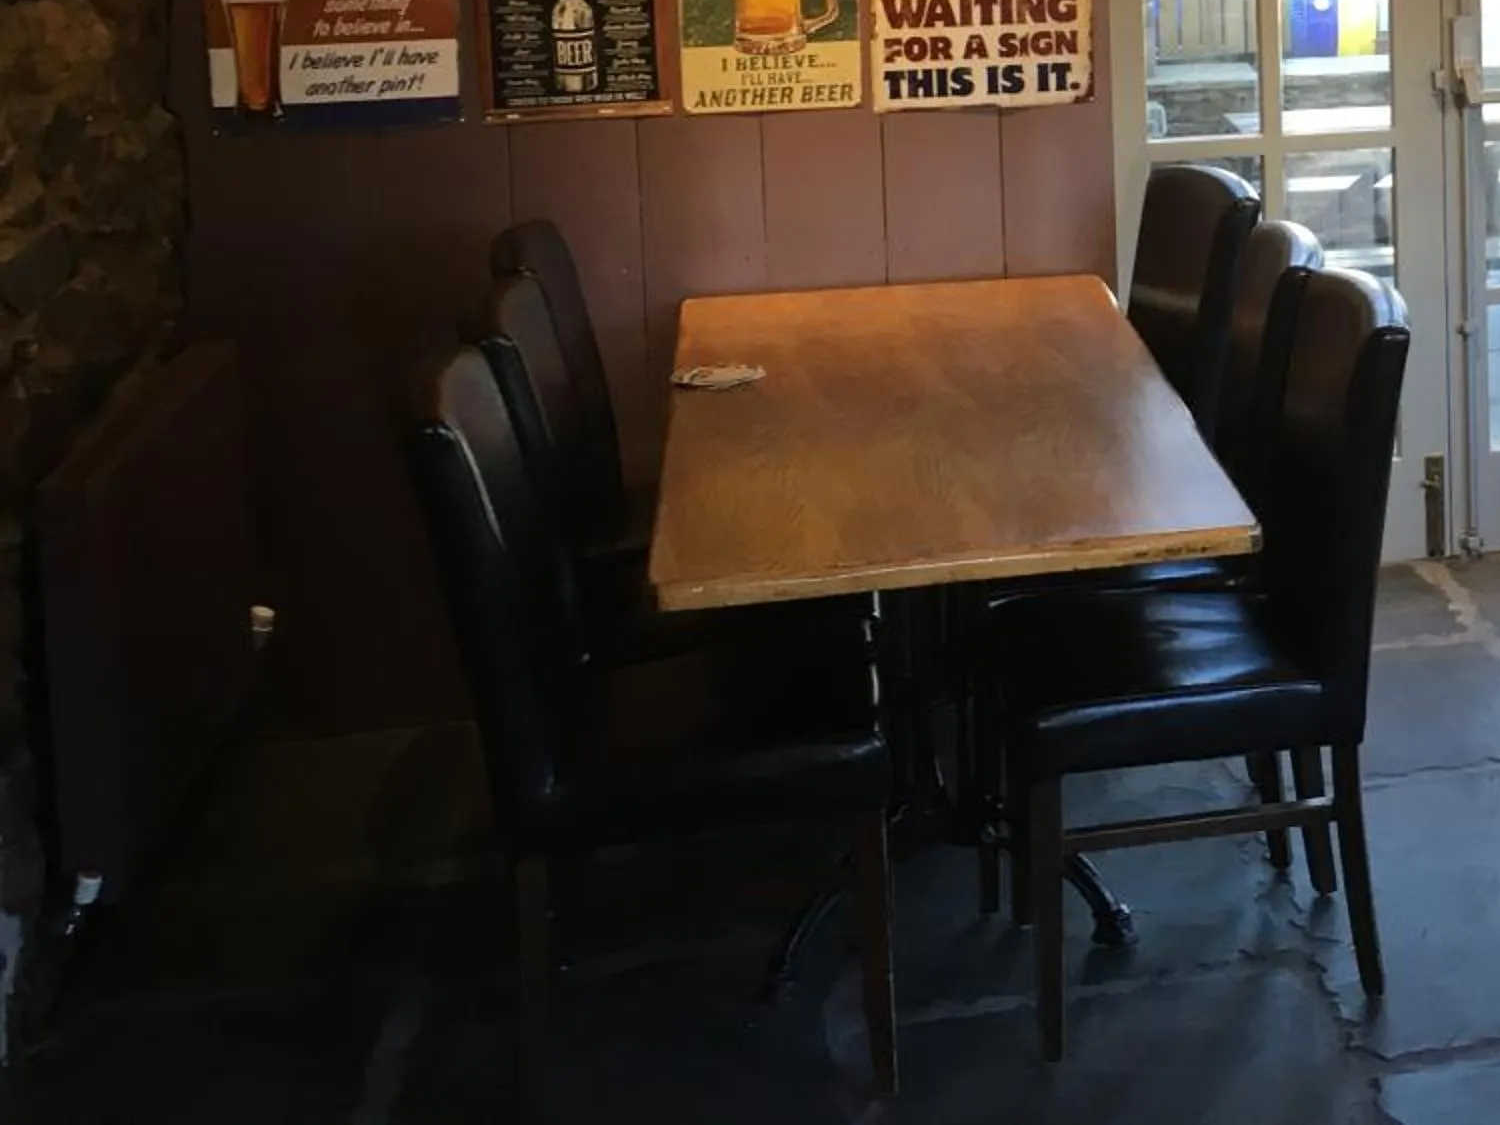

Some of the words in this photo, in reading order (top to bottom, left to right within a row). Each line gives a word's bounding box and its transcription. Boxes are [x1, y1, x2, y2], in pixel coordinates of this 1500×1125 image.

[884, 36, 952, 63] FOR
[963, 34, 988, 59] A
[999, 30, 1078, 57] SIGN
[302, 49, 361, 70] believe
[397, 48, 440, 65] have
[721, 58, 728, 72] I
[306, 74, 373, 97] another
[884, 67, 974, 99] THIS
[987, 64, 1025, 95] IS
[1037, 63, 1081, 92] IT.
[695, 86, 793, 108] ANOTHER
[801, 83, 854, 102] BEER
